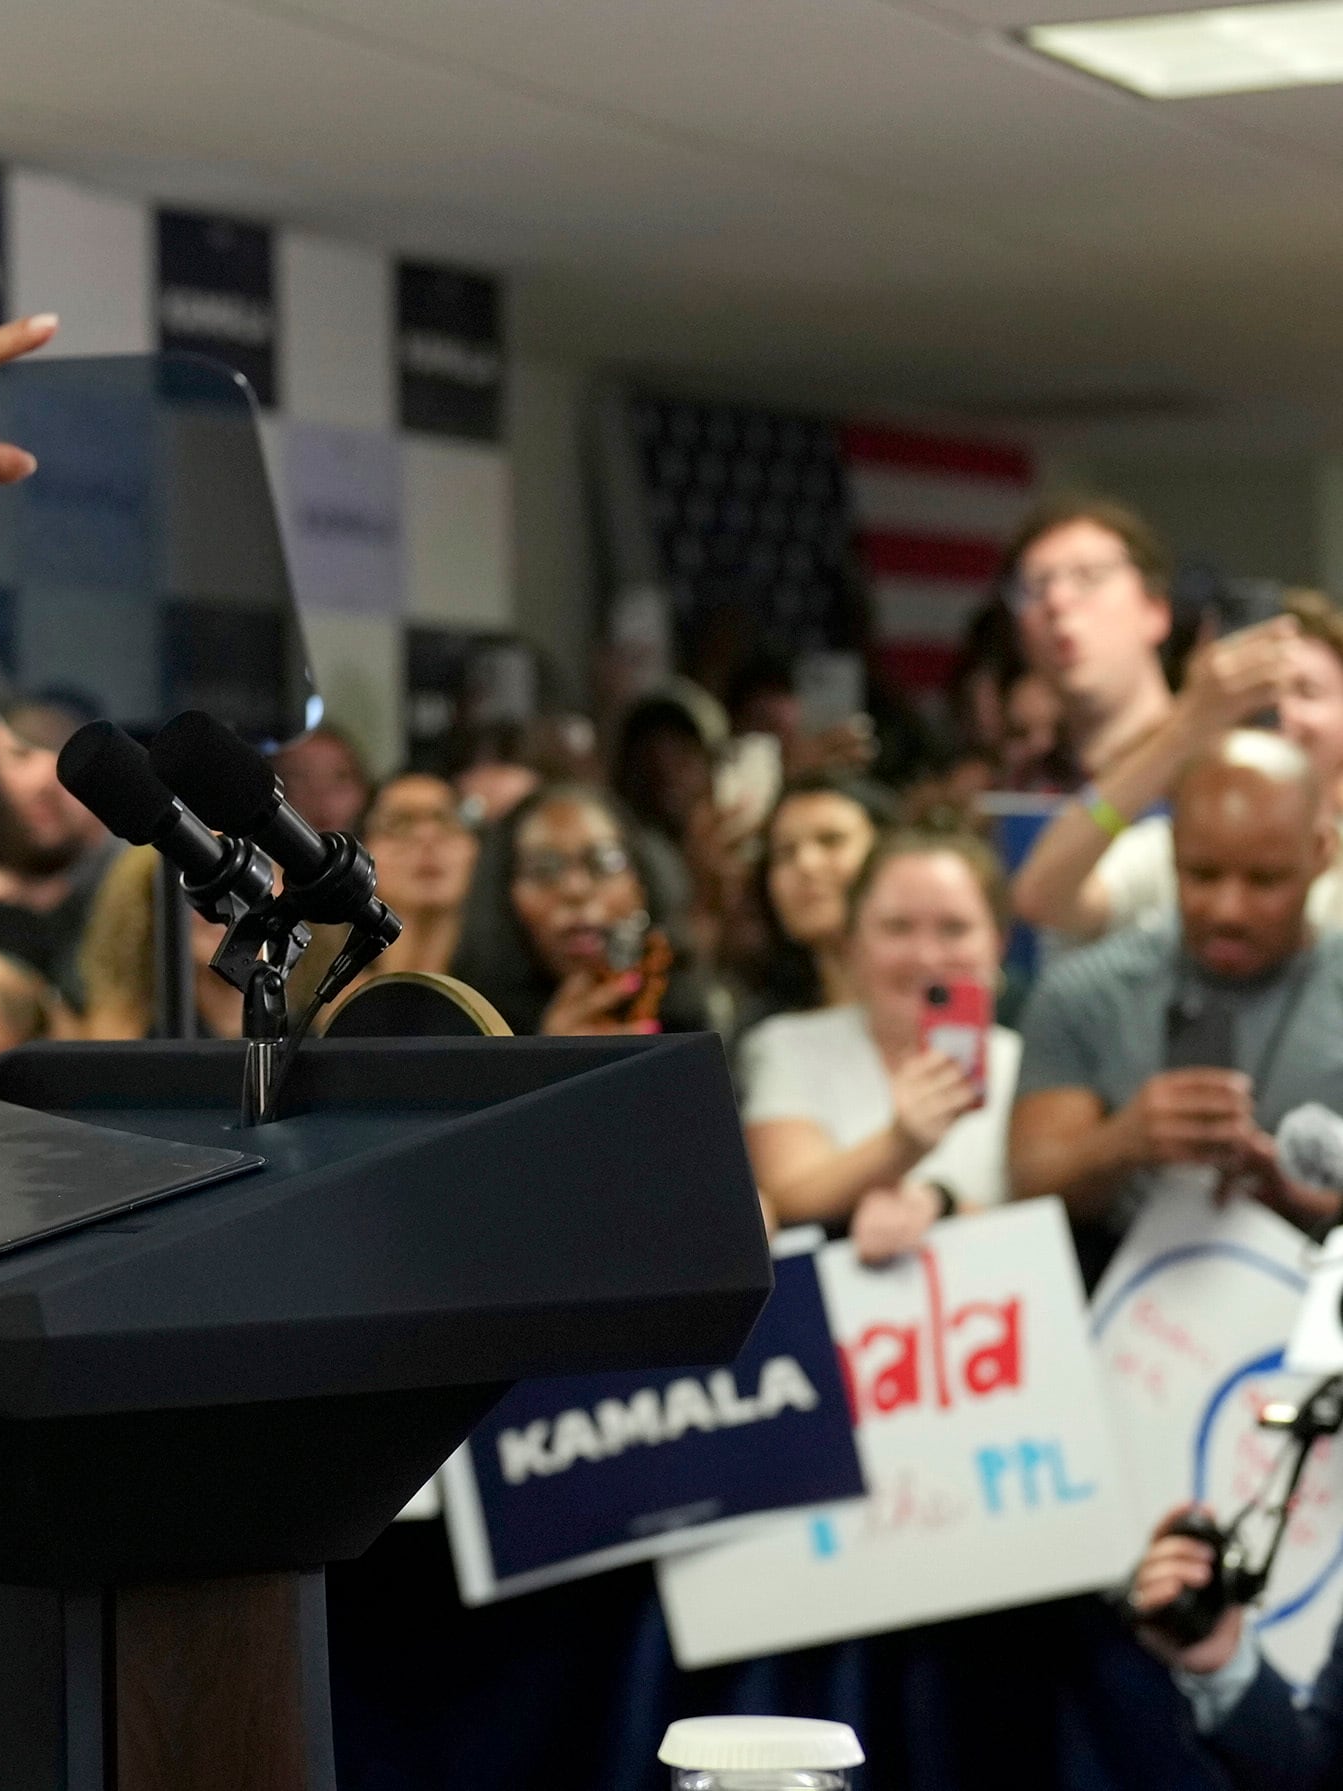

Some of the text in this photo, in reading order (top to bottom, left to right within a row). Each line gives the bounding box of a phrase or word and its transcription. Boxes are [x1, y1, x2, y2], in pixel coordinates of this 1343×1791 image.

[838, 1247, 1022, 1427] ala
[498, 1356, 817, 1483] KAMALA
[973, 1437, 1094, 1513] PPL
